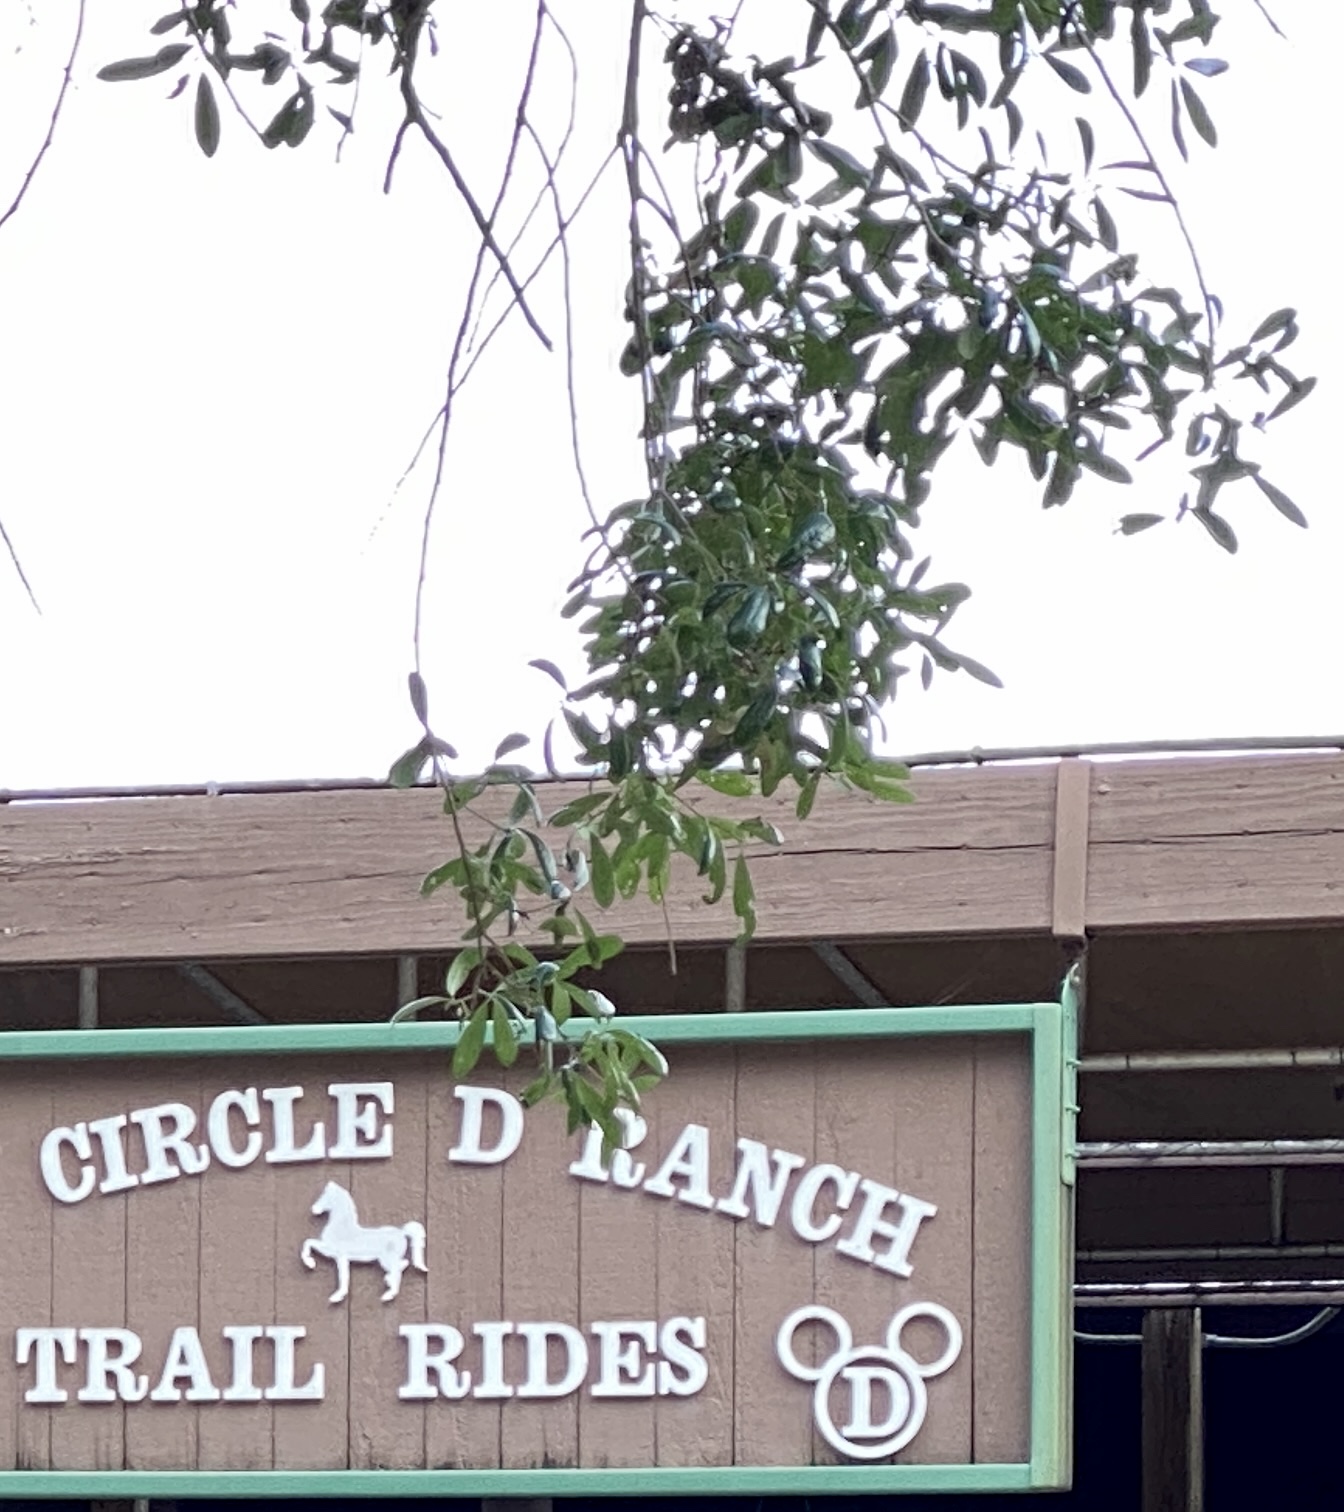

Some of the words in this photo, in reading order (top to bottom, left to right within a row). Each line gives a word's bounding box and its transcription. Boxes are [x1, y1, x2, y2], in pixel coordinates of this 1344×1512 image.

[39, 1080, 396, 1204] CIRCLE
[447, 1083, 525, 1164] D
[567, 1104, 940, 1279] RANCH
[15, 1324, 327, 1404] TRAIL
[397, 1314, 710, 1399] RIDES
[839, 1365, 911, 1438] D
